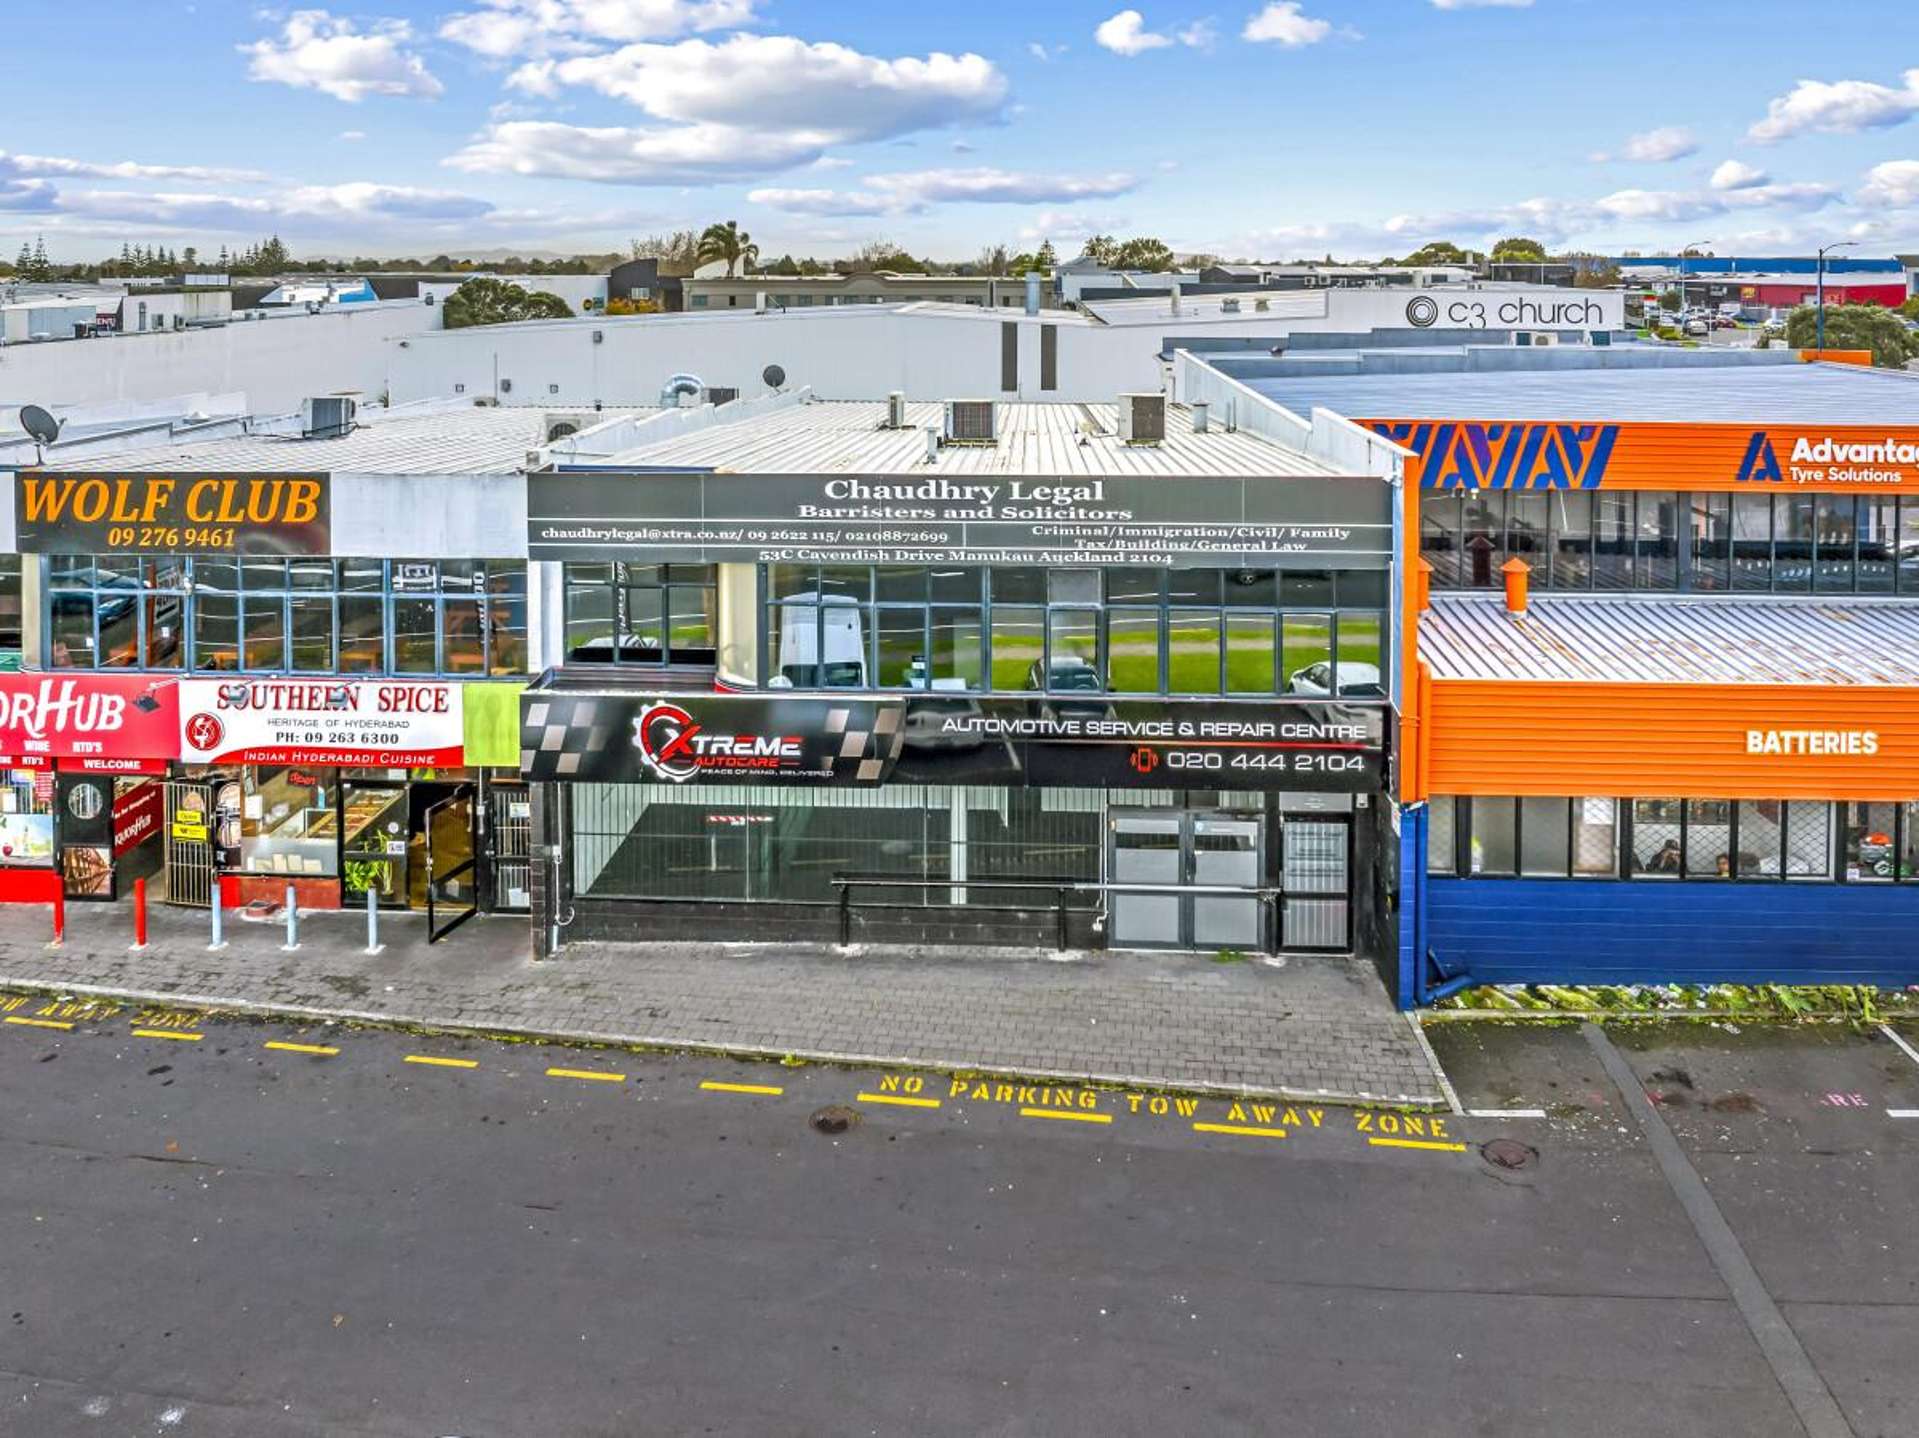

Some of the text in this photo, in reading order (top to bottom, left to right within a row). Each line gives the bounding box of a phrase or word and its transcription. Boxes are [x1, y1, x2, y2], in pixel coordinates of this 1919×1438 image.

[1498, 296, 1602, 324] church
[1790, 467, 1902, 484] Tyre Solutions
[22, 479, 321, 524] WOLF CLUB
[823, 479, 1105, 507] Chaudhry Legal
[797, 504, 1133, 521] Barristers and Solicitors
[107, 527, 235, 547] 09 276 9461
[541, 527, 744, 543] chaudhrylegal@xtra.co.nz/
[747, 529, 767, 543] 09
[770, 529, 808, 541] 2622
[845, 530, 948, 544] 02108872699
[1290, 527, 1350, 540] Family
[1271, 541, 1307, 551] Law
[759, 549, 1174, 565] 53C Cavendish Drive Manukau Auckland 2104
[378, 686, 449, 713] SPICE
[267, 718, 411, 729] HERITAGE OF HYDERABAD
[942, 719, 1367, 739] AUTOMOTIVE SERVICE & REPAIR CENTRE
[276, 731, 400, 745] PH: 09 263 6300
[659, 724, 804, 763] XTREME
[1746, 729, 1879, 755] BATTERIES
[83, 759, 141, 770] WELCOME
[693, 757, 780, 767] AUTOCARE
[1167, 751, 1365, 772] 020 444 2104
[700, 768, 732, 776] PEACE
[734, 768, 748, 776] OF
[879, 1074, 1449, 1140] NO PARKING TOW AWAY ZONE
